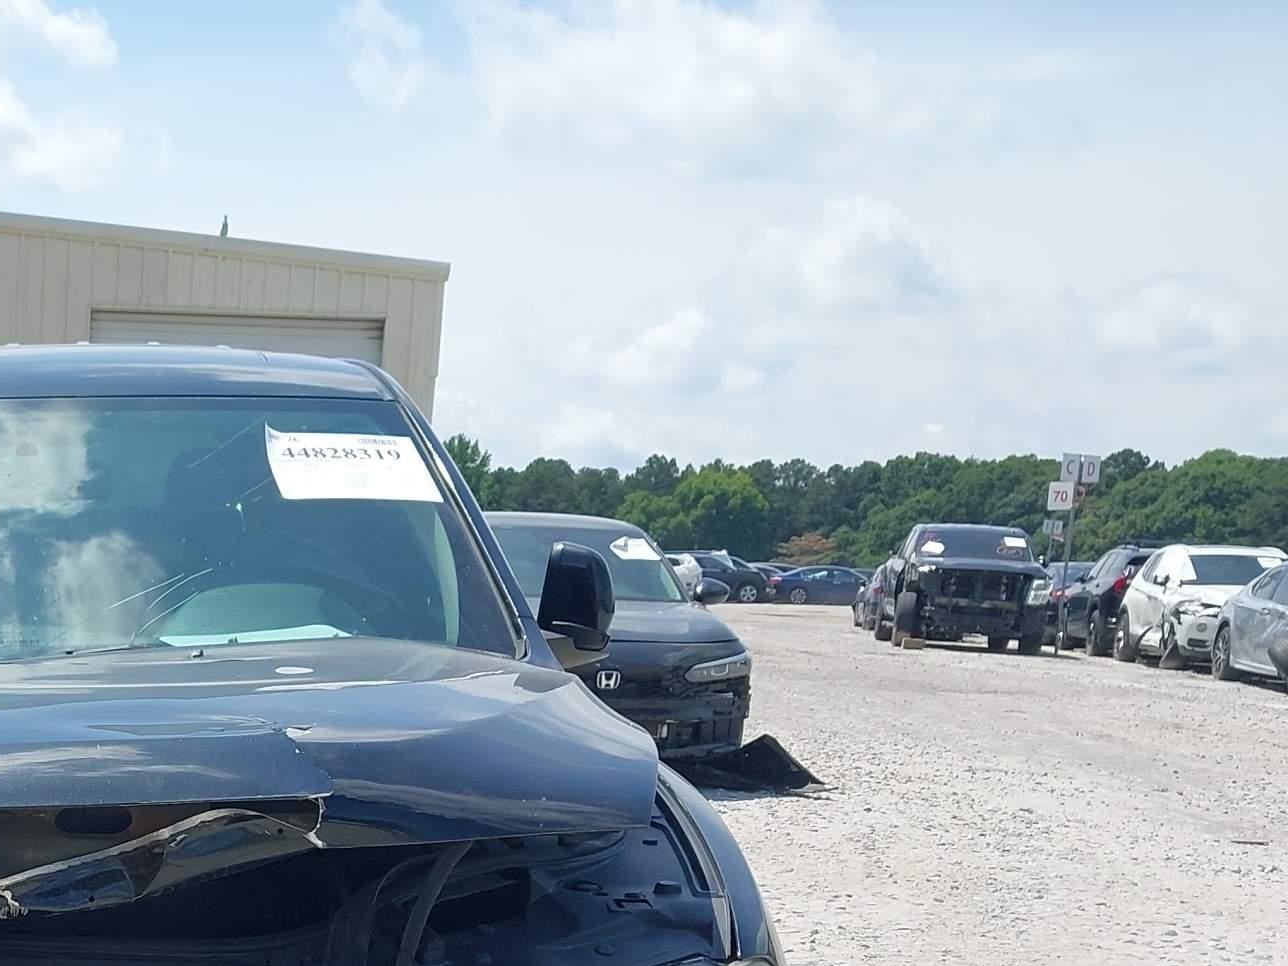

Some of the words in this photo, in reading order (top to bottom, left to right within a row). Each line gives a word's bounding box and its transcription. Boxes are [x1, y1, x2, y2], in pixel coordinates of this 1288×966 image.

[281, 446, 401, 462] 44828319
[1066, 459, 1075, 475] C
[1087, 460, 1096, 477] D
[1053, 490, 1069, 503] 70
